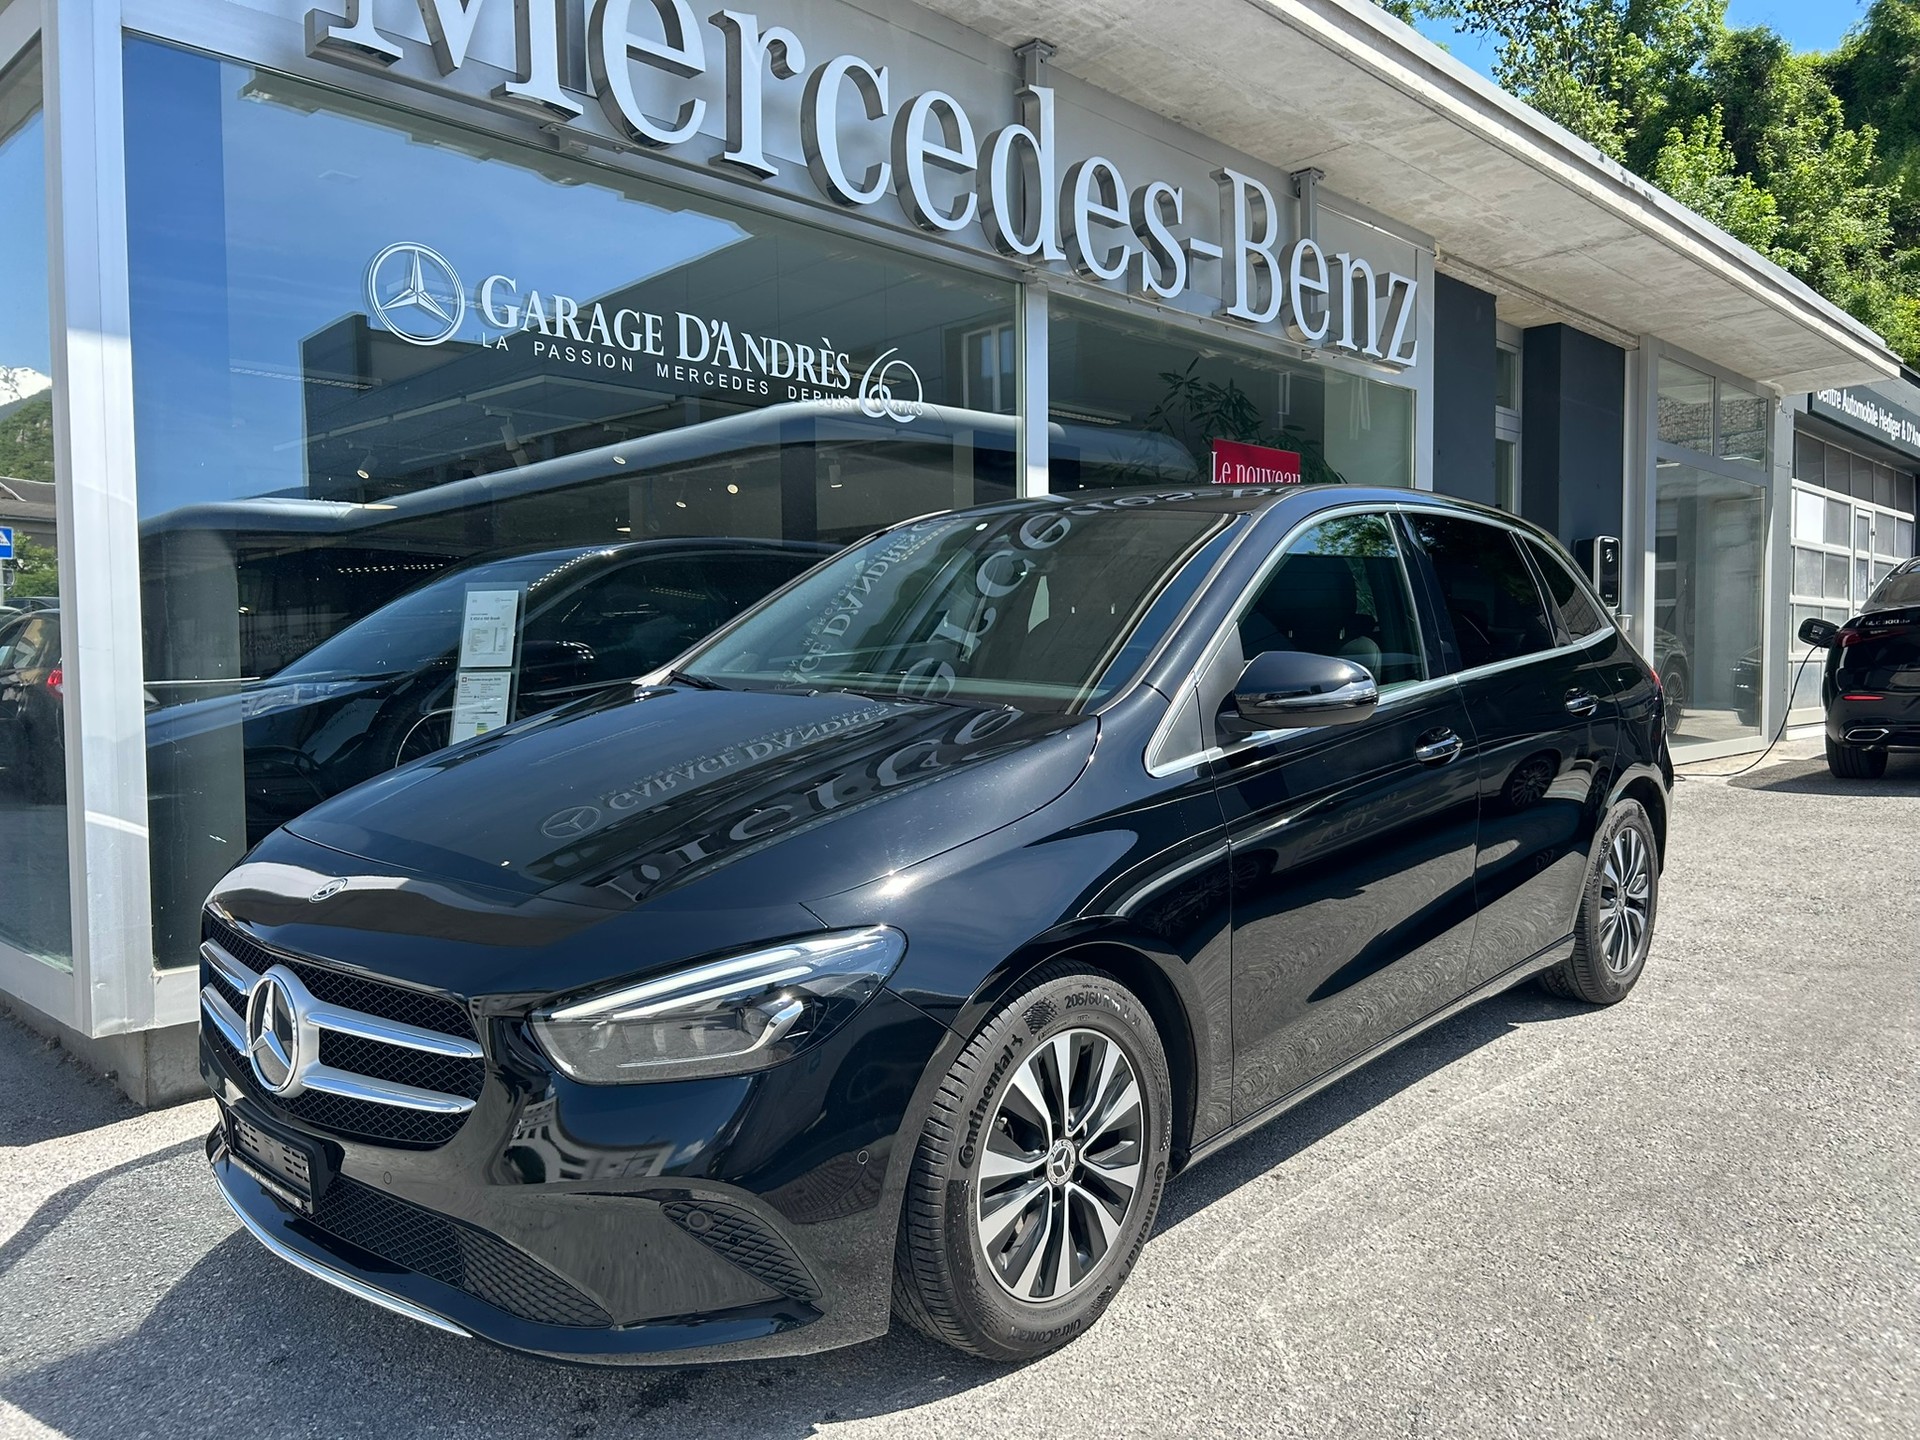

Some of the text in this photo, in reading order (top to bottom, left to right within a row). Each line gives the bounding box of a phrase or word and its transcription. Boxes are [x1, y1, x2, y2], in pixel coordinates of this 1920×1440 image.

[306, 0, 1418, 368] ercedes-Benz
[481, 274, 665, 357] GARAGE
[481, 331, 510, 352] LA
[534, 341, 633, 373] PASSION
[656, 362, 770, 395] MERCEDES
[1841, 388, 1879, 427] Automobile
[1901, 419, 1906, 440] &
[1211, 451, 1231, 485] Le
[958, 1044, 1015, 1169] Continental
[1123, 1160, 1165, 1269] Continental
